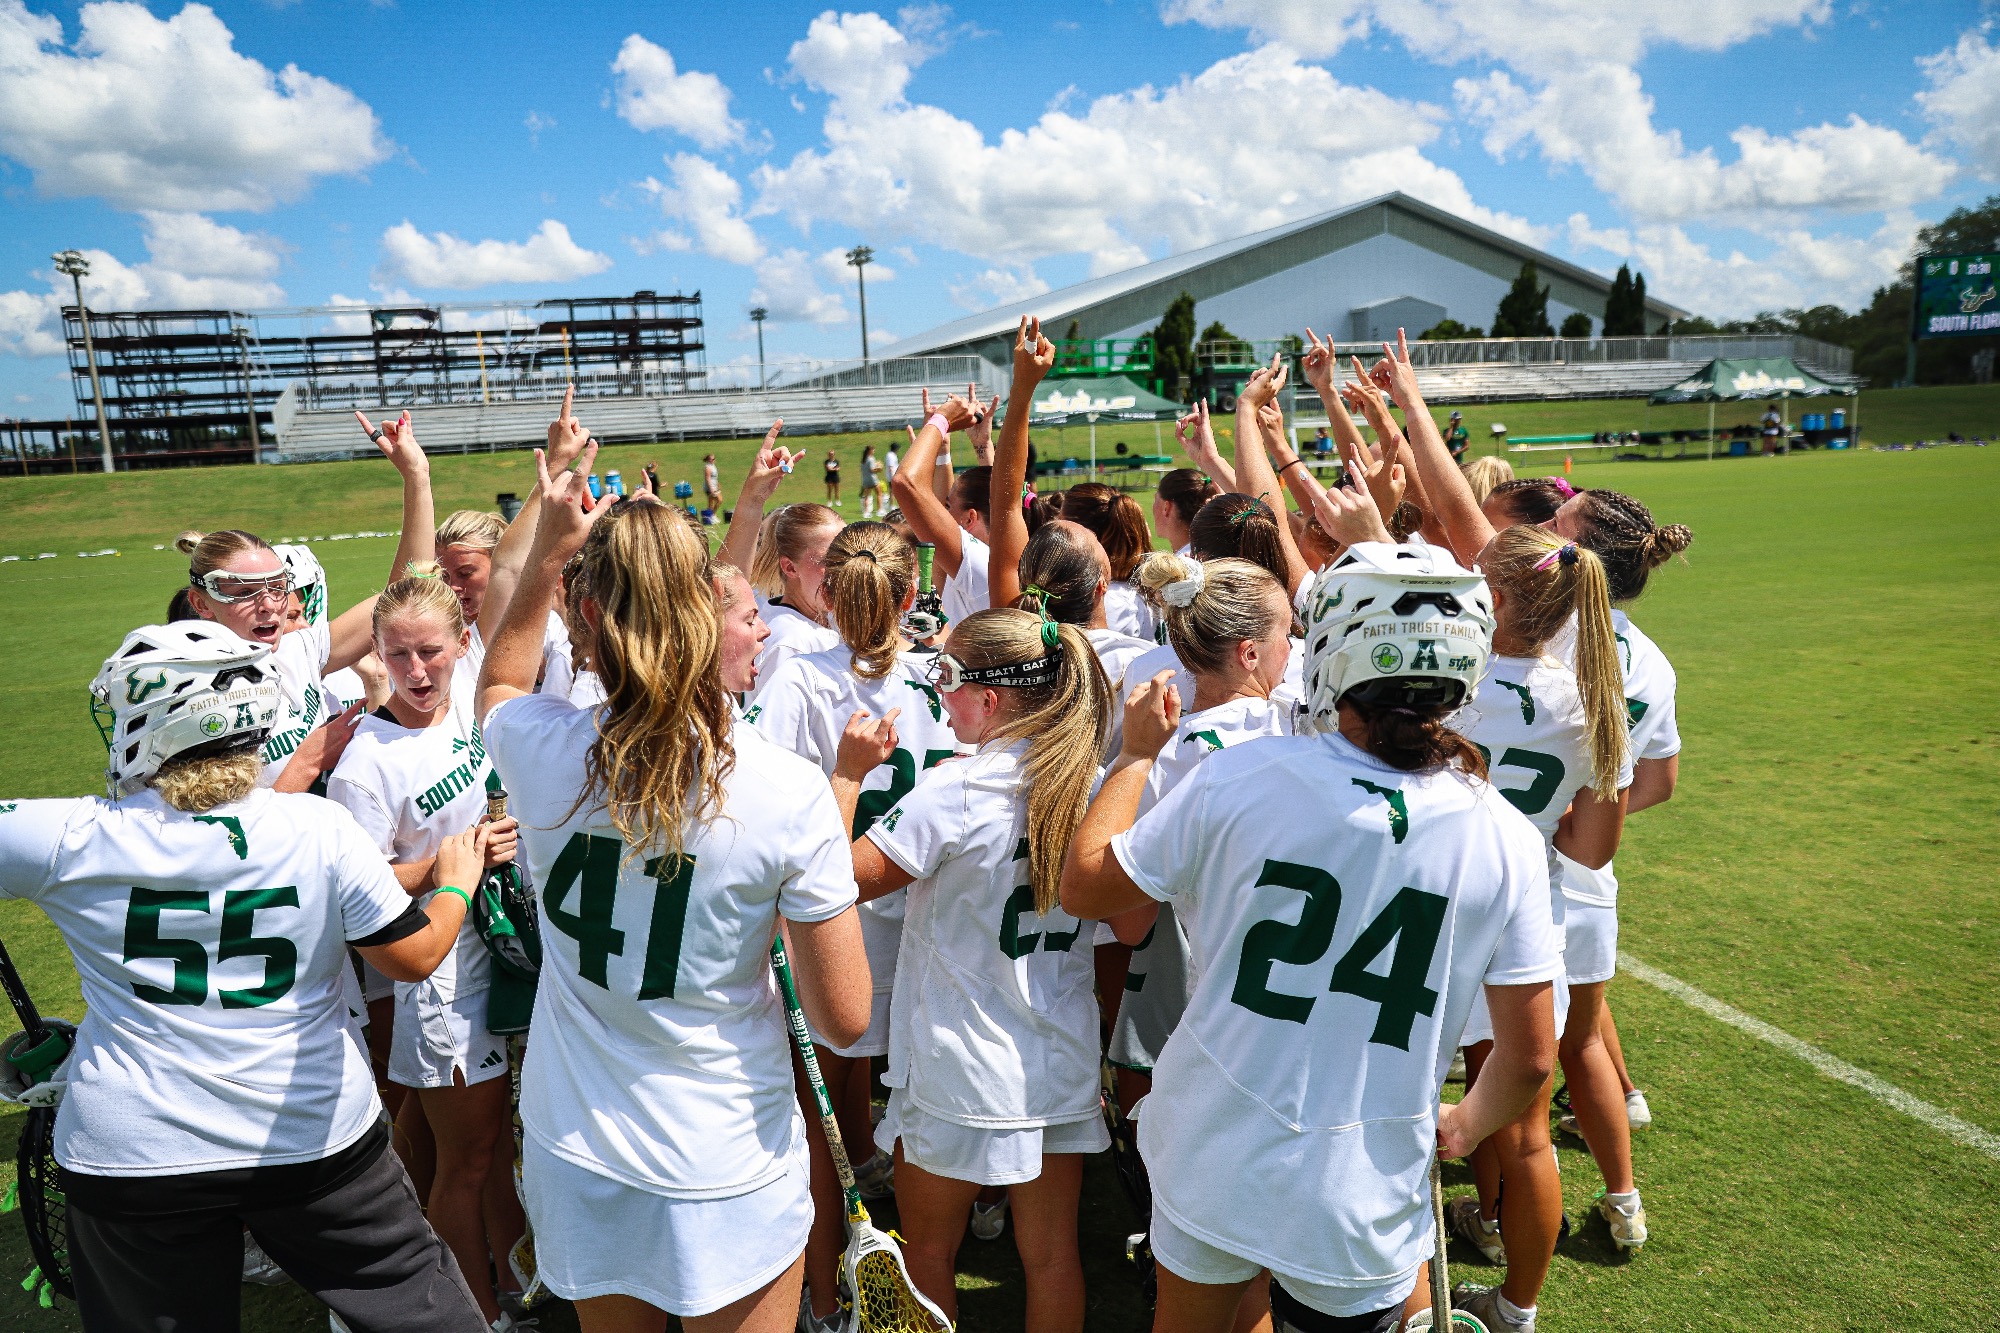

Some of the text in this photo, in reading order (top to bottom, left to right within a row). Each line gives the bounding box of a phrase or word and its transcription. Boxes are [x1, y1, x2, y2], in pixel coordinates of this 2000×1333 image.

[1929, 315, 1969, 333] SOUTH
[1363, 622, 1478, 640] FAITH TRUST FAMILY
[960, 671, 980, 681] AIT
[986, 667, 1016, 678] GAIT
[1022, 658, 1049, 672] GAIT
[190, 696, 220, 714] FAITH
[224, 688, 252, 703] TRUST
[415, 763, 475, 818] SOUTH
[543, 832, 697, 1000] 41
[123, 886, 301, 1010] 55
[1231, 858, 1450, 1053] 24
[789, 1007, 825, 1089] SOUTH FLORIDA
